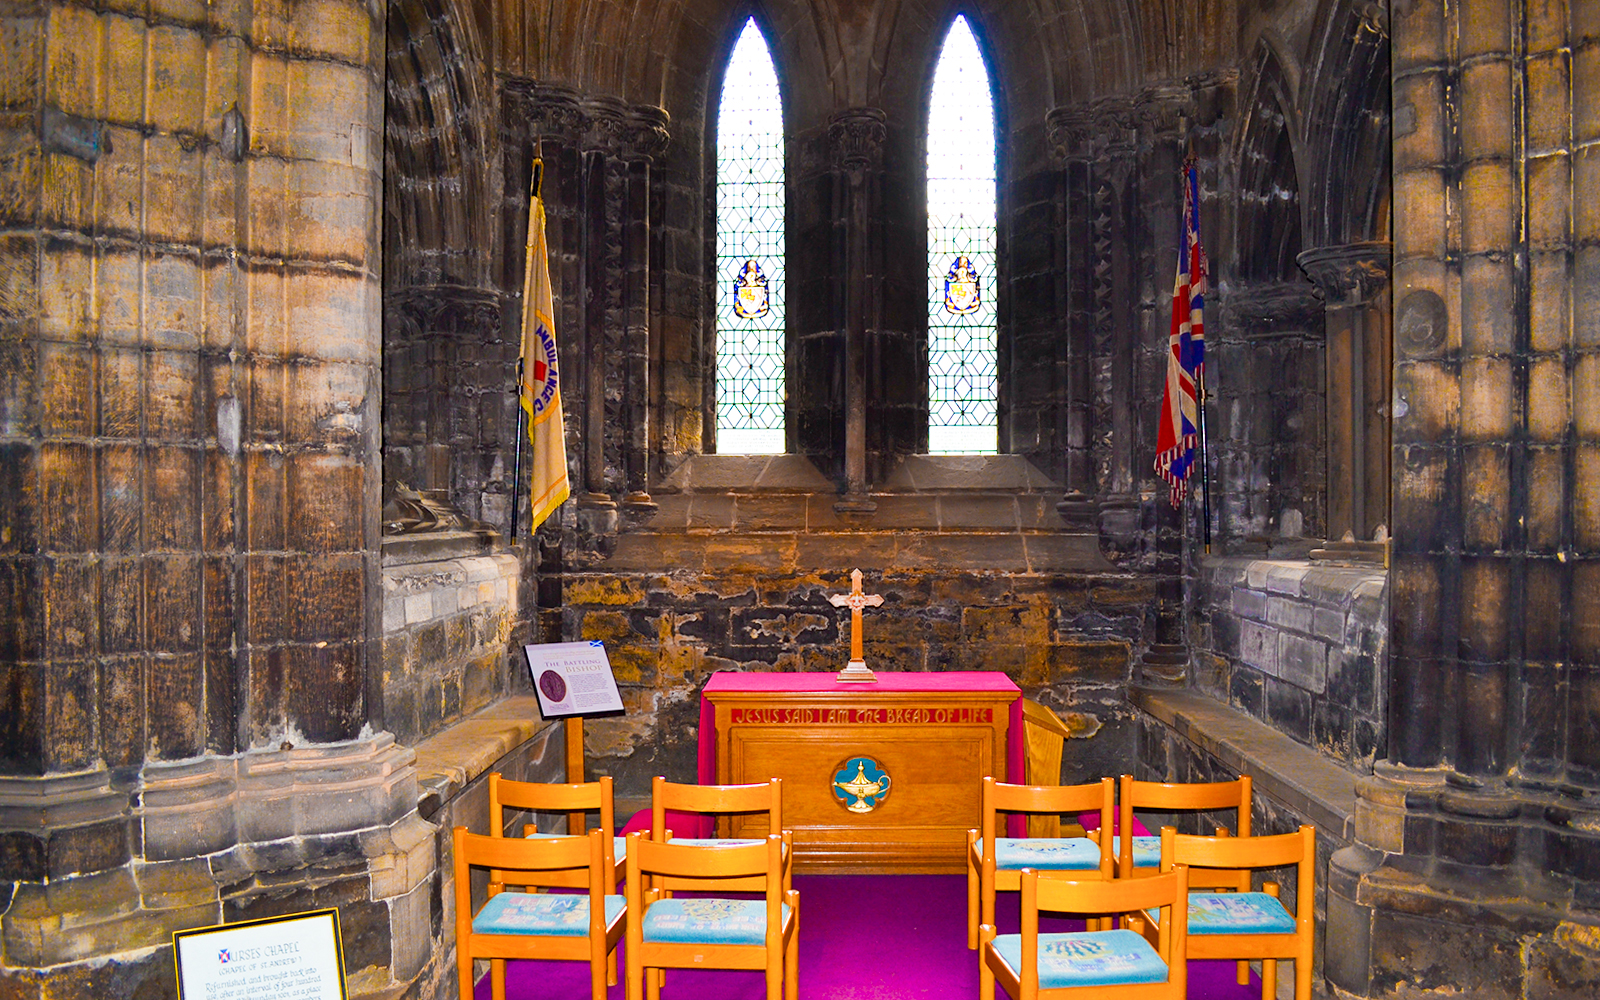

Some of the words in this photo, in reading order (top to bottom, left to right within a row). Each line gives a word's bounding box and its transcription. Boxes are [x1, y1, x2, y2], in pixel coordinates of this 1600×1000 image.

[563, 659, 601, 667] BATTLING
[565, 664, 603, 674] BISHOP
[735, 709, 780, 723] JESUS
[784, 709, 813, 723] SAID
[819, 709, 823, 723] I
[887, 709, 930, 723] BREAD
[935, 709, 955, 723] OF
[960, 709, 987, 723] LIFE
[263, 941, 300, 957] CHAPEL
[248, 974, 262, 984] and
